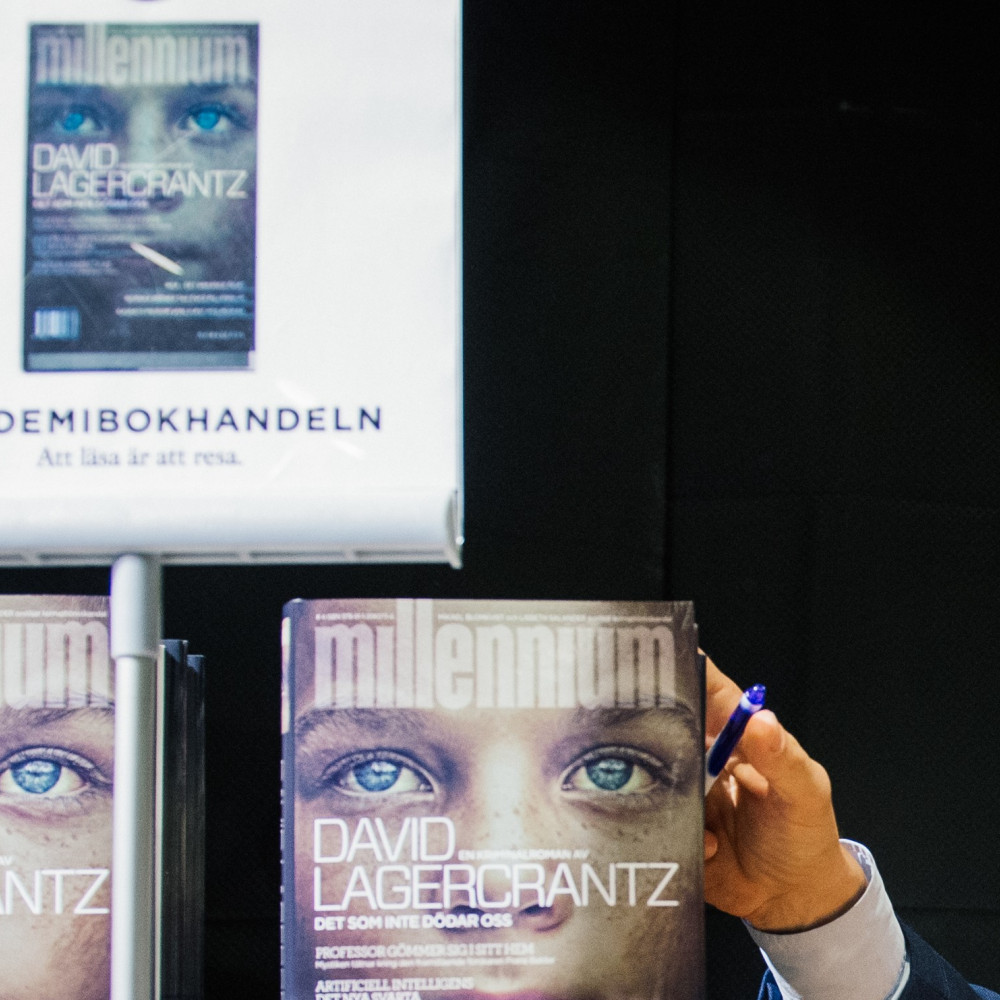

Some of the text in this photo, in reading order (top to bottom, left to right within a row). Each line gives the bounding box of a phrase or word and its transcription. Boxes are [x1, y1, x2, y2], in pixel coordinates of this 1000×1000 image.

[36, 24, 250, 86] millennium
[32, 143, 118, 172] DAVID
[32, 170, 249, 199] LAGERCRANTZ
[0, 408, 382, 434] DEMIBOKHANDELN
[37, 446, 243, 467] Att läsa är att resa.
[314, 599, 676, 710] millennium
[314, 816, 456, 864] DAVID
[314, 861, 680, 913] LAGERCRANTZ
[314, 911, 513, 931] DET SOM INTE DÖDAR OSS
